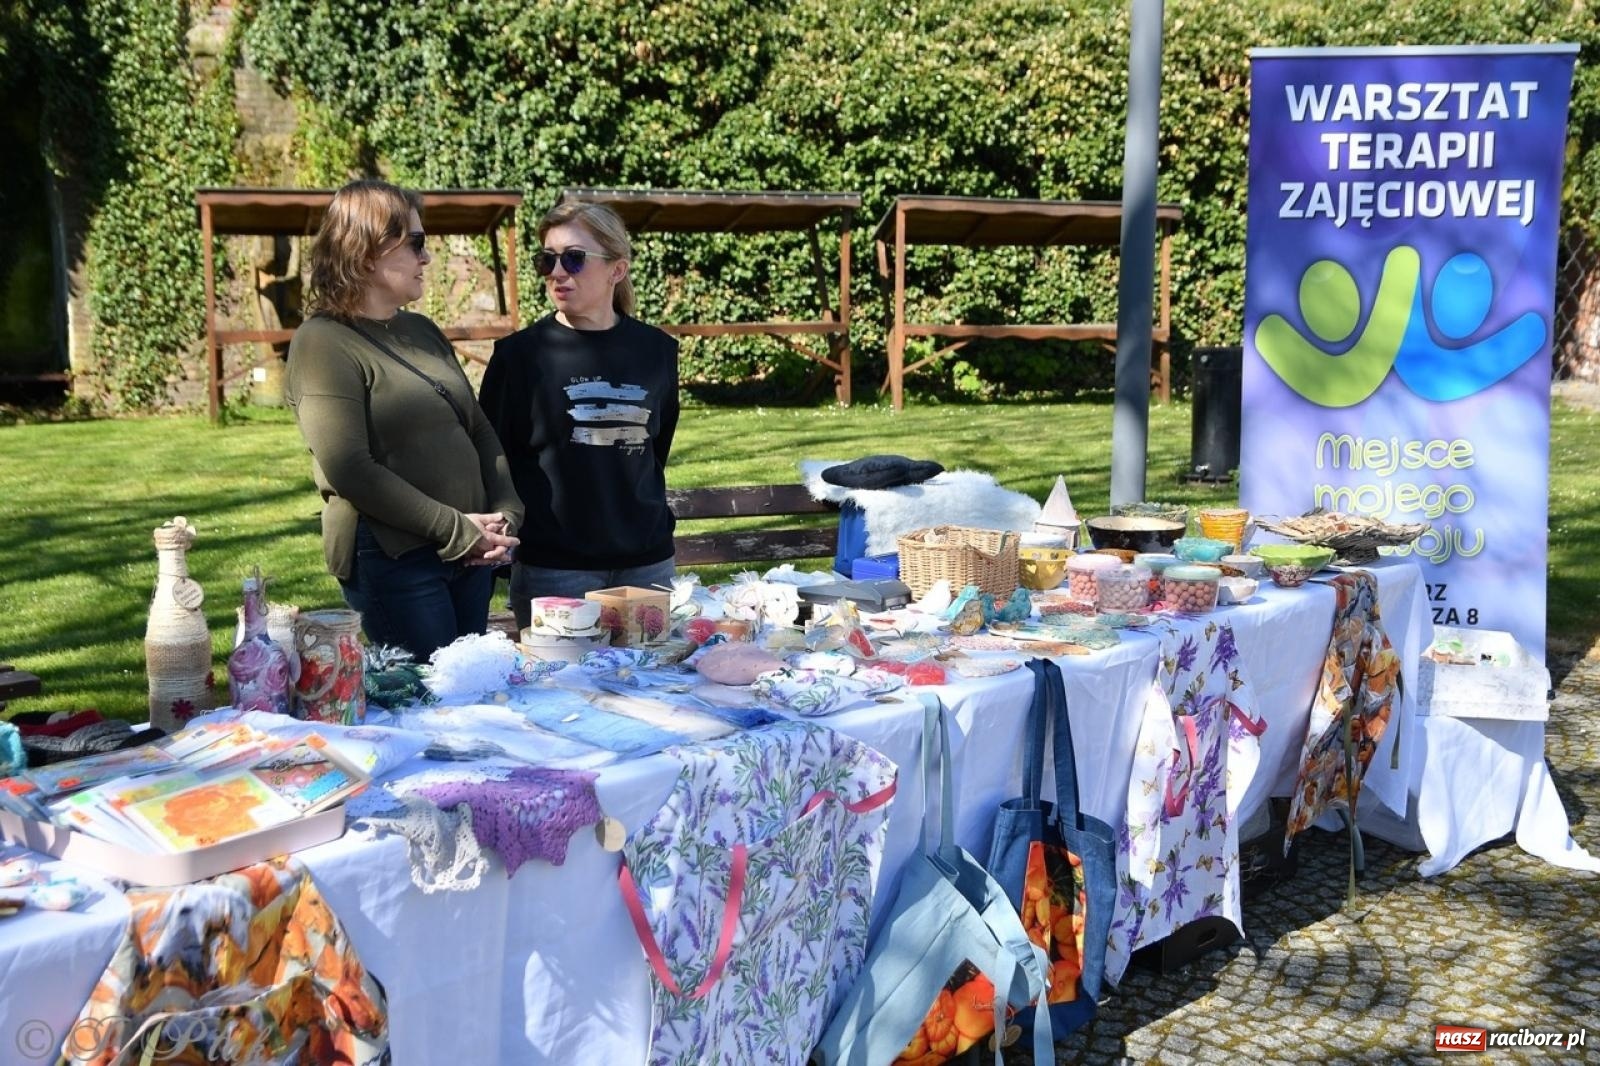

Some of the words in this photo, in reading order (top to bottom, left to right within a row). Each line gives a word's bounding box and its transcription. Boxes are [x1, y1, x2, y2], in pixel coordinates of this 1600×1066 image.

[1285, 81, 1538, 121] WARSZTAT
[1320, 131, 1495, 169] TERAPII
[1279, 179, 1535, 228] ZAJĘCIOWEJ
[1314, 480, 1475, 519] mojego
[1466, 608, 1479, 625] 8
